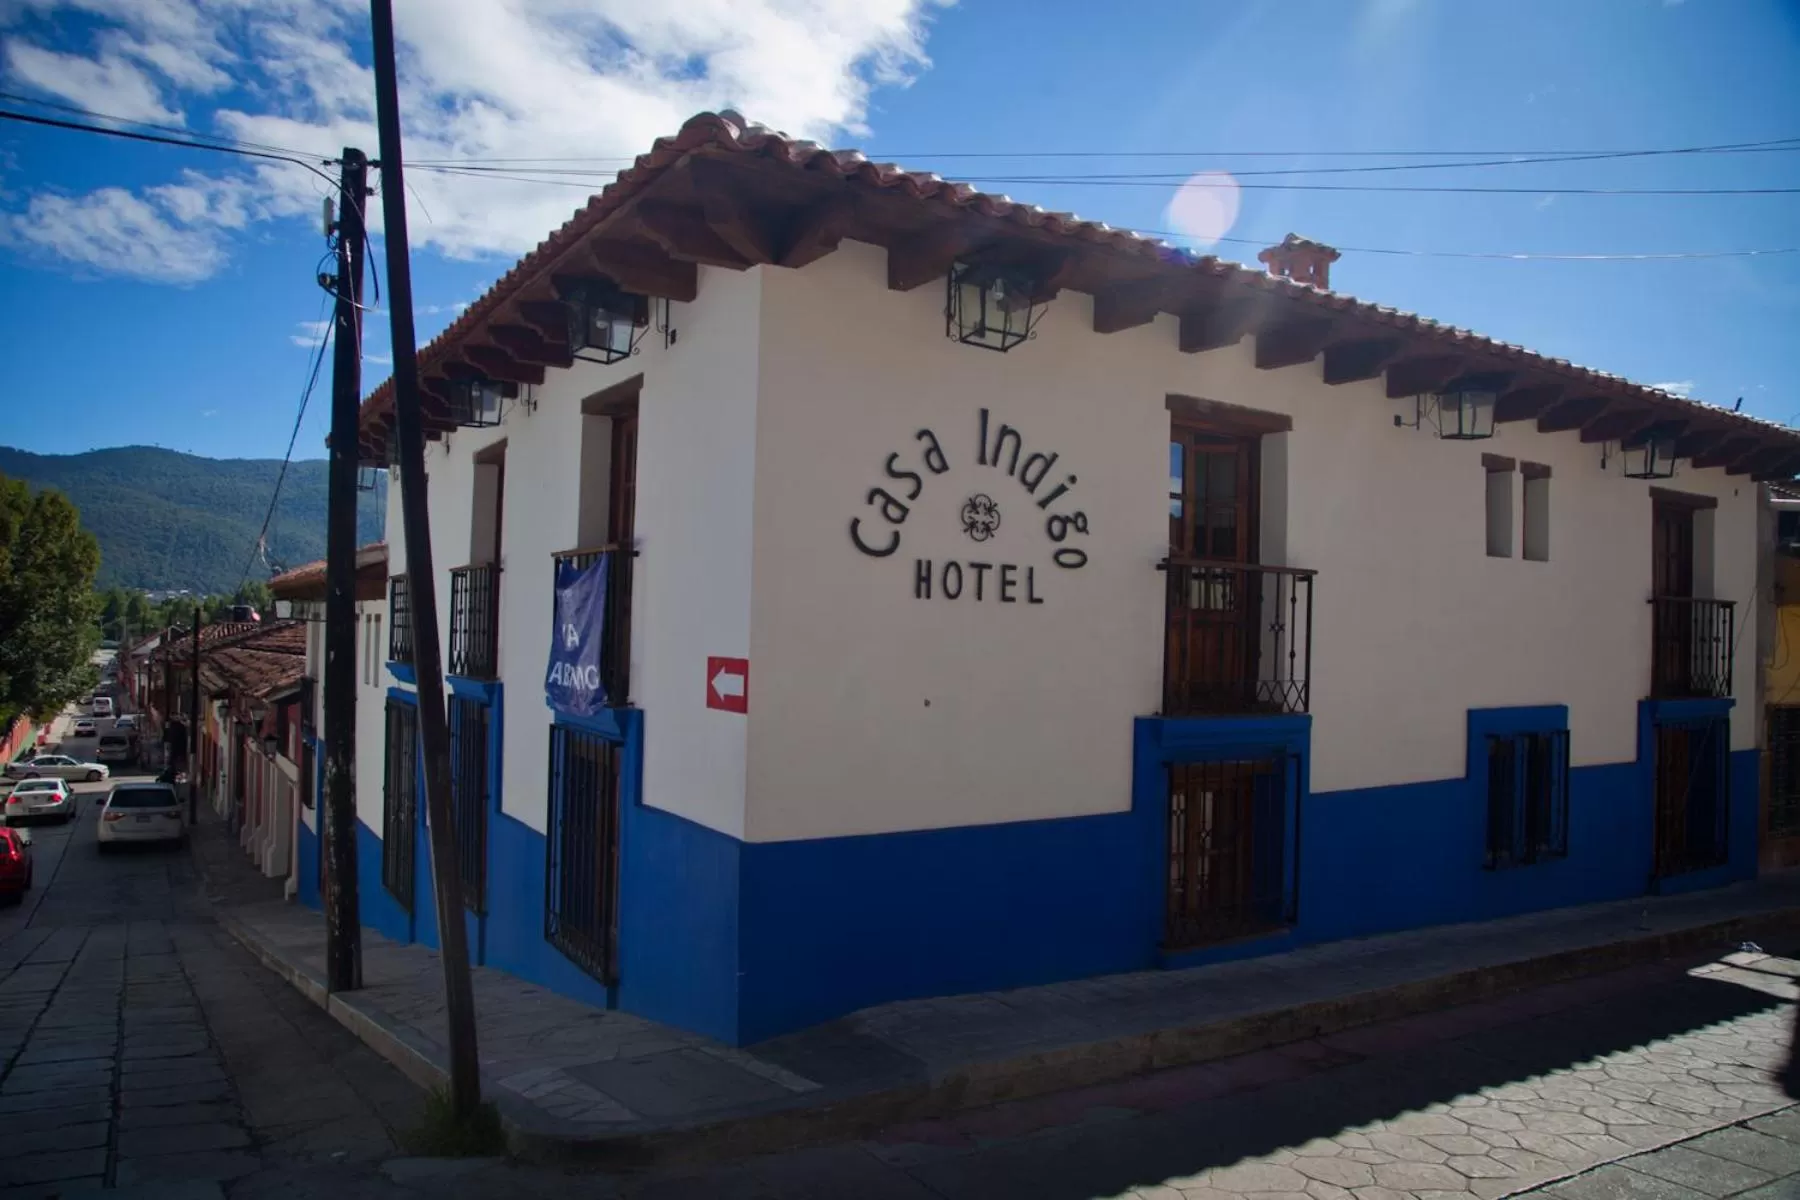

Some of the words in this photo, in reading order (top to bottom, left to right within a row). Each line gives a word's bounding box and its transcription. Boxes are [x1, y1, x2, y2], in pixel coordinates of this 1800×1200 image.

[850, 428, 949, 557] Casa
[976, 408, 1089, 569] Indigo
[915, 559, 1044, 604] HOTEL
